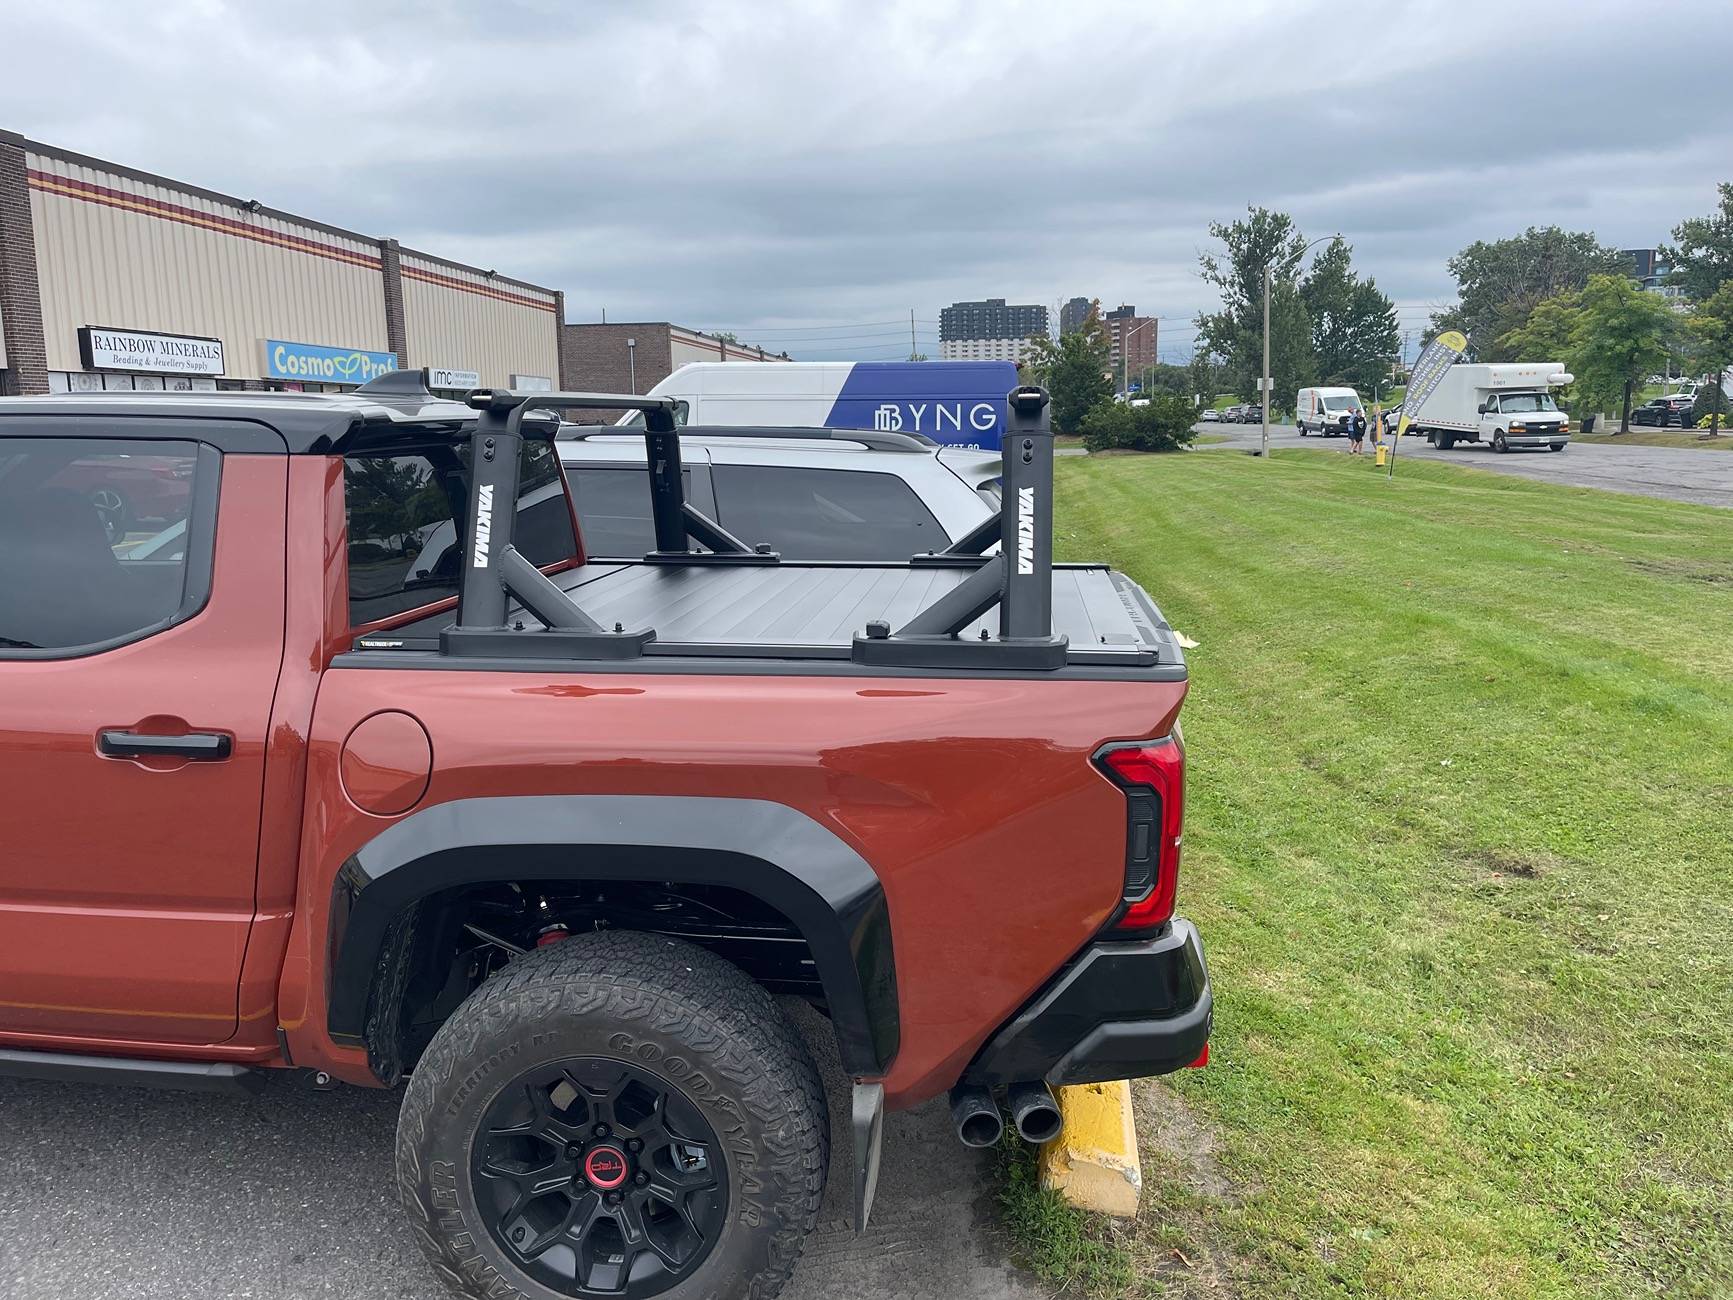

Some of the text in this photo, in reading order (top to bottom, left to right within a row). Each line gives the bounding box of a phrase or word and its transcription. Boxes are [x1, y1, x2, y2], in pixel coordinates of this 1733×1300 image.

[93, 335, 220, 360] RAINBOW MINERALS
[113, 354, 208, 371] Beading & Jewellery Supply
[274, 346, 334, 377] Cosmo
[1411, 340, 1442, 378] OVERLAND
[1410, 362, 1435, 392] HITCHES
[1413, 379, 1430, 400] ROOF
[1426, 362, 1451, 392] HITCHES
[875, 403, 996, 431] BYNG
[473, 484, 494, 568] YAKIMA
[1018, 487, 1034, 575] YAKIMA
